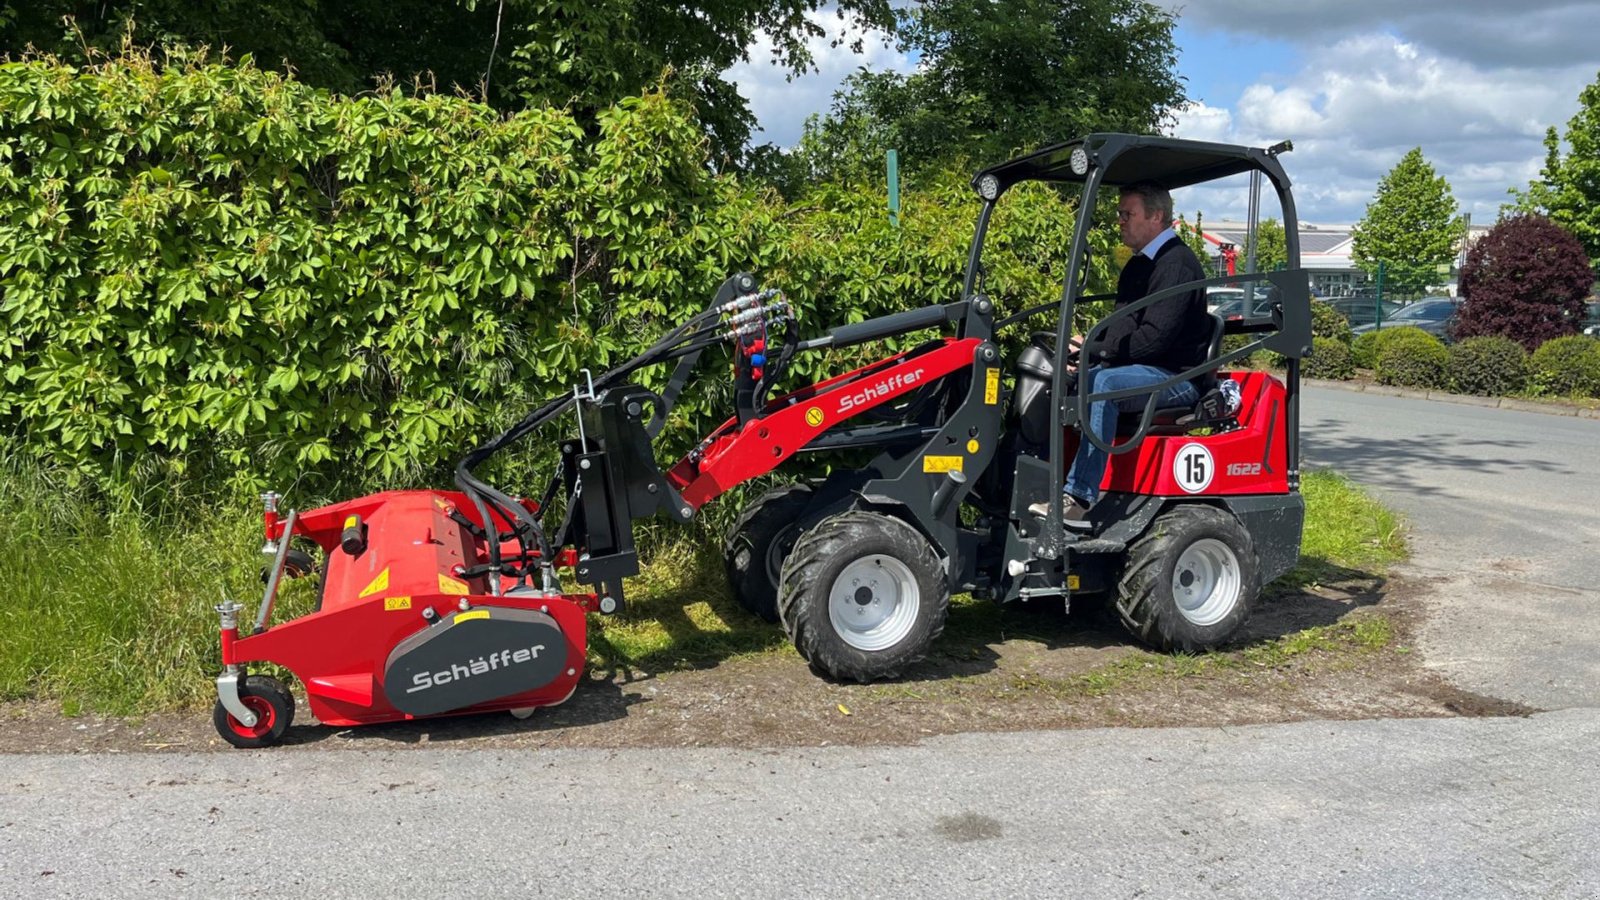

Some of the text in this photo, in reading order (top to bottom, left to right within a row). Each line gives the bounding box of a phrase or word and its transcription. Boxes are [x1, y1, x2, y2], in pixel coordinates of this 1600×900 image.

[837, 368, 924, 414] Schäffer
[1184, 453, 1205, 484] 15
[1226, 463, 1261, 476] 1622
[406, 644, 545, 694] Schäffer
